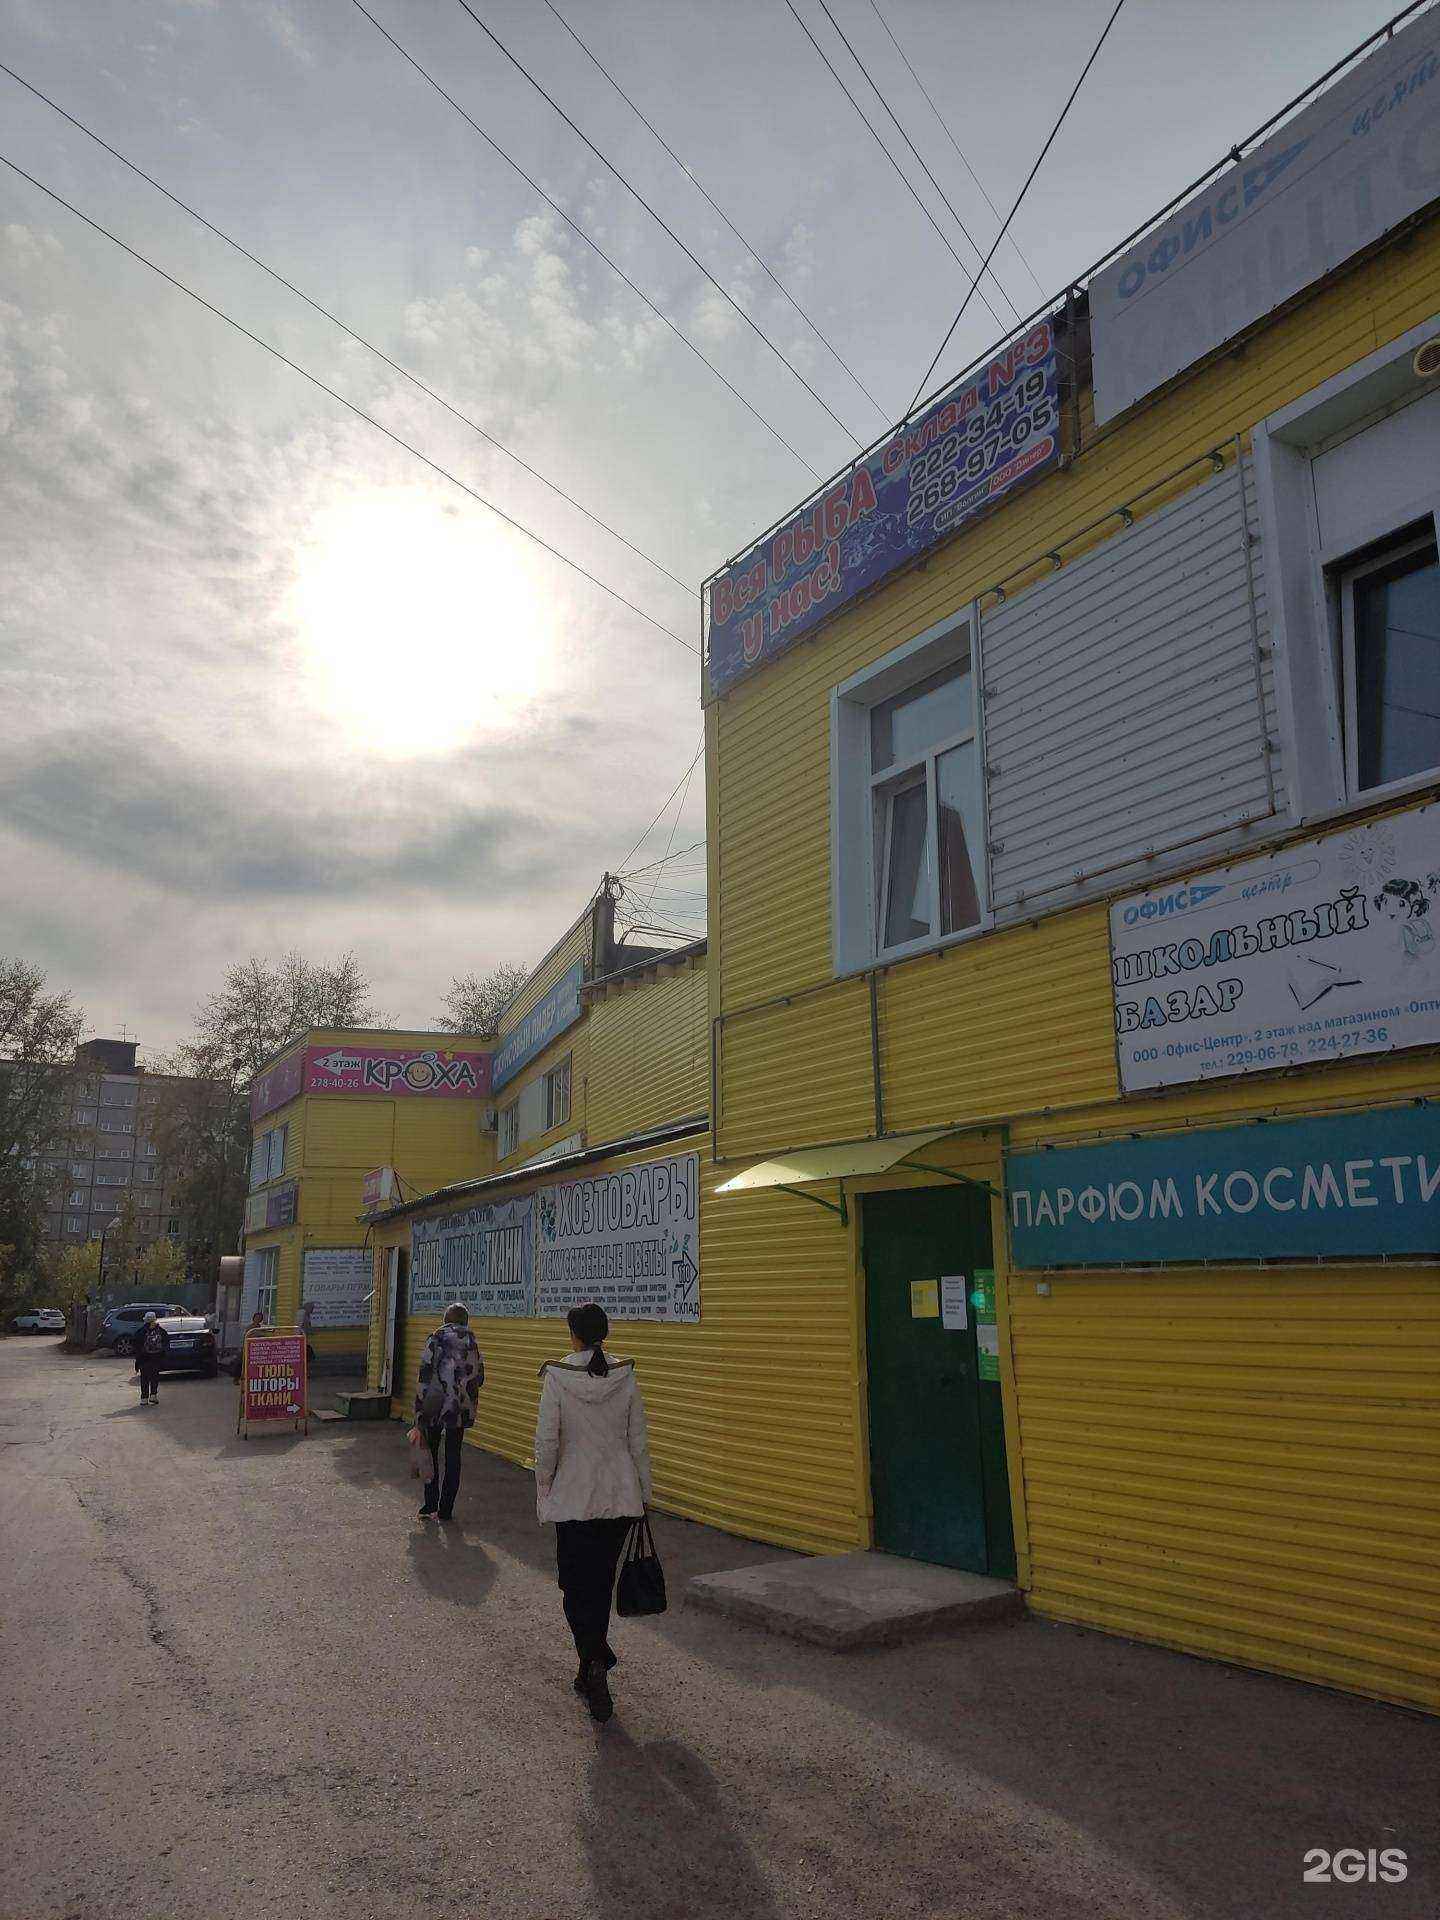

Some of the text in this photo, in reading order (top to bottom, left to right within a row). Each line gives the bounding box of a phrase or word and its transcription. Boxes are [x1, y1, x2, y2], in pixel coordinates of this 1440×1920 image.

[1118, 194, 1240, 299] ОФИС
[908, 367, 1046, 490] 222-34-19
[907, 399, 1053, 525] 268-97-05
[713, 560, 767, 625] Вся
[772, 466, 877, 582] РЫБА
[769, 543, 842, 634] нас!
[1123, 871, 1293, 925] ОФИС центр
[1114, 885, 1370, 987] ШКОЛЬНЫЙ
[1116, 978, 1244, 1033] БАЗАР
[1132, 1048, 1159, 1063] ООО
[1254, 1030, 1262, 1042] 2
[1265, 1026, 1296, 1041] этаж
[1298, 1022, 1322, 1036] над
[1324, 1007, 1400, 1029] магазином
[1307, 1027, 1389, 1051] 224-27-36
[322, 1057, 362, 1069] 2 этаж
[364, 1051, 477, 1091] КРОХА
[559, 1158, 695, 1237] ХОЗТОВАРЫ
[1012, 1154, 1440, 1229] ПАРФЮМ КОСМЕТИ
[484, 1225, 524, 1285] ТКАНИ
[625, 1239, 667, 1284] ЦВЕТЫ
[673, 1302, 700, 1317] СКЛАД
[249, 1377, 300, 1392] ШТОРЫ
[257, 1364, 294, 1378] ТЮЛЬ
[249, 1392, 293, 1406] ТКАНИ
